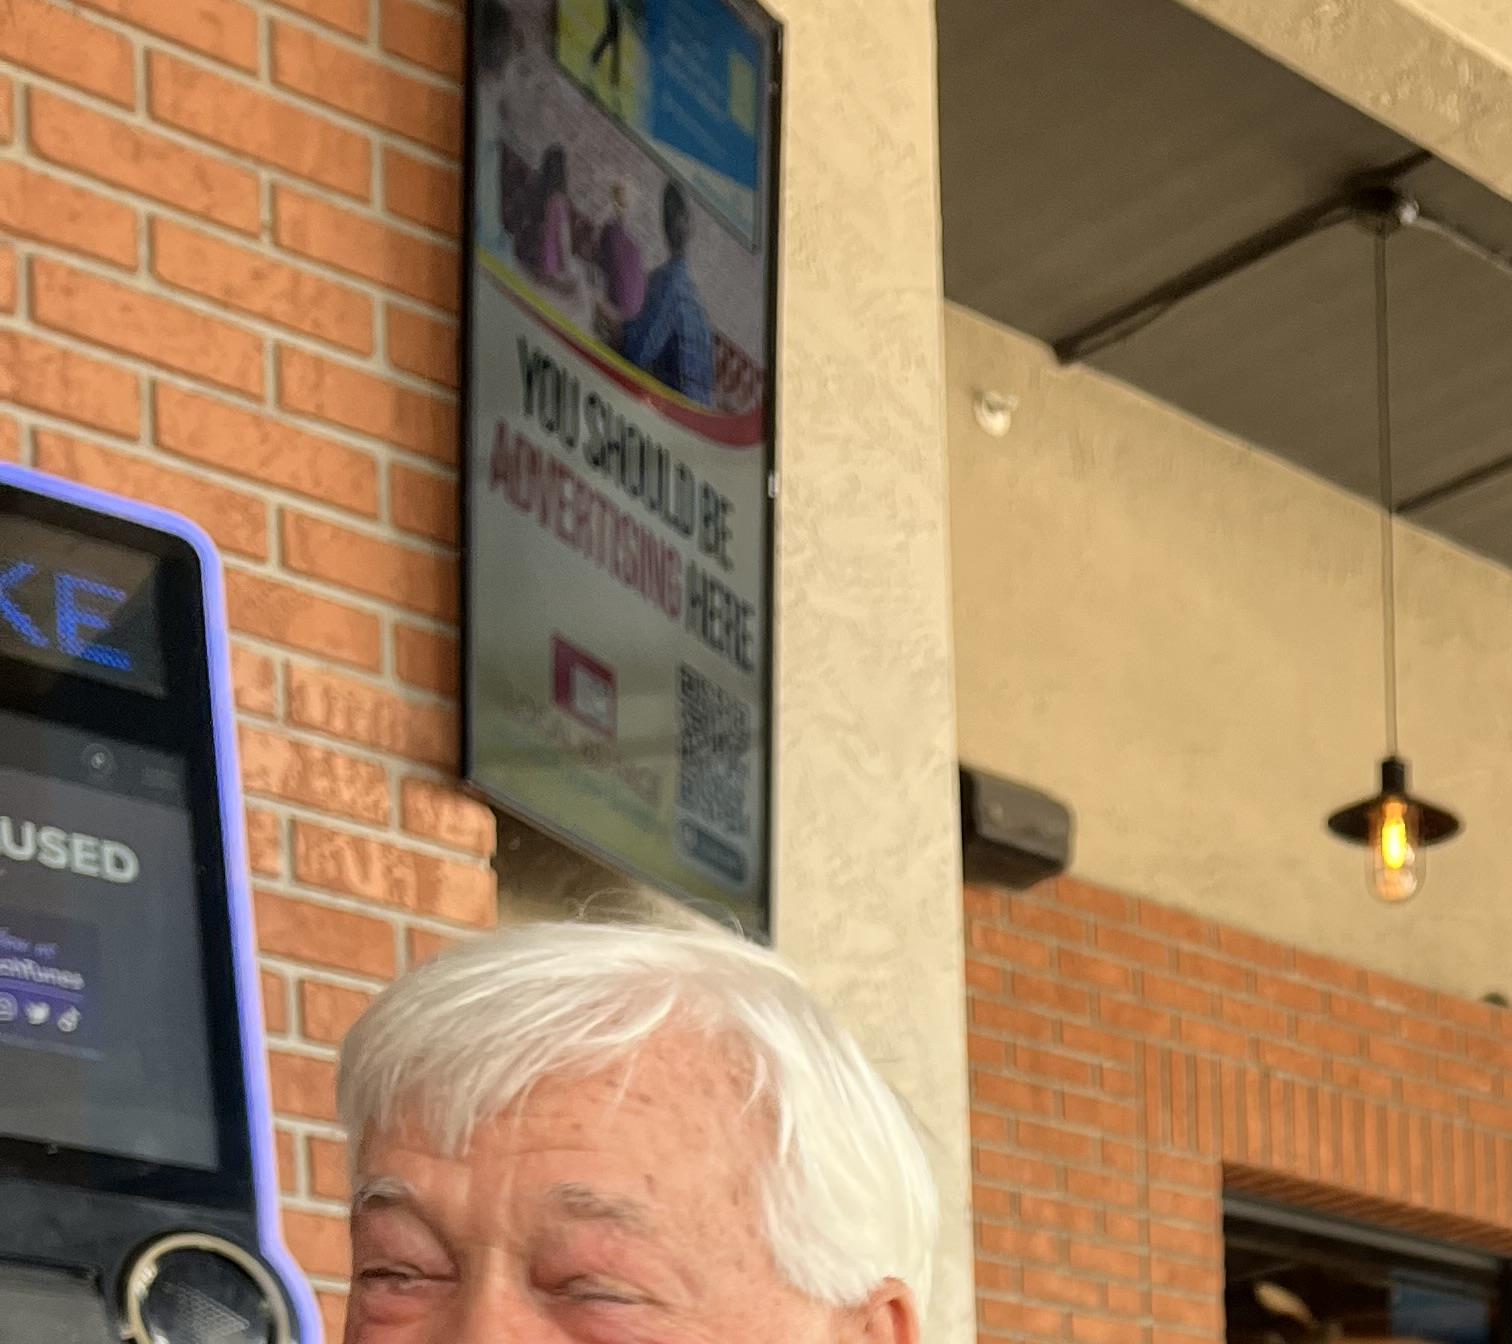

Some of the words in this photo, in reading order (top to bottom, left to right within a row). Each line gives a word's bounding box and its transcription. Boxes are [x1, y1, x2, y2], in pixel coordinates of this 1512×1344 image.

[489, 415, 684, 622] ADVERTISING
[684, 558, 755, 674] HERE
[517, 335, 580, 450] YOU
[582, 391, 697, 540] SHOULD
[698, 479, 734, 573] BE
